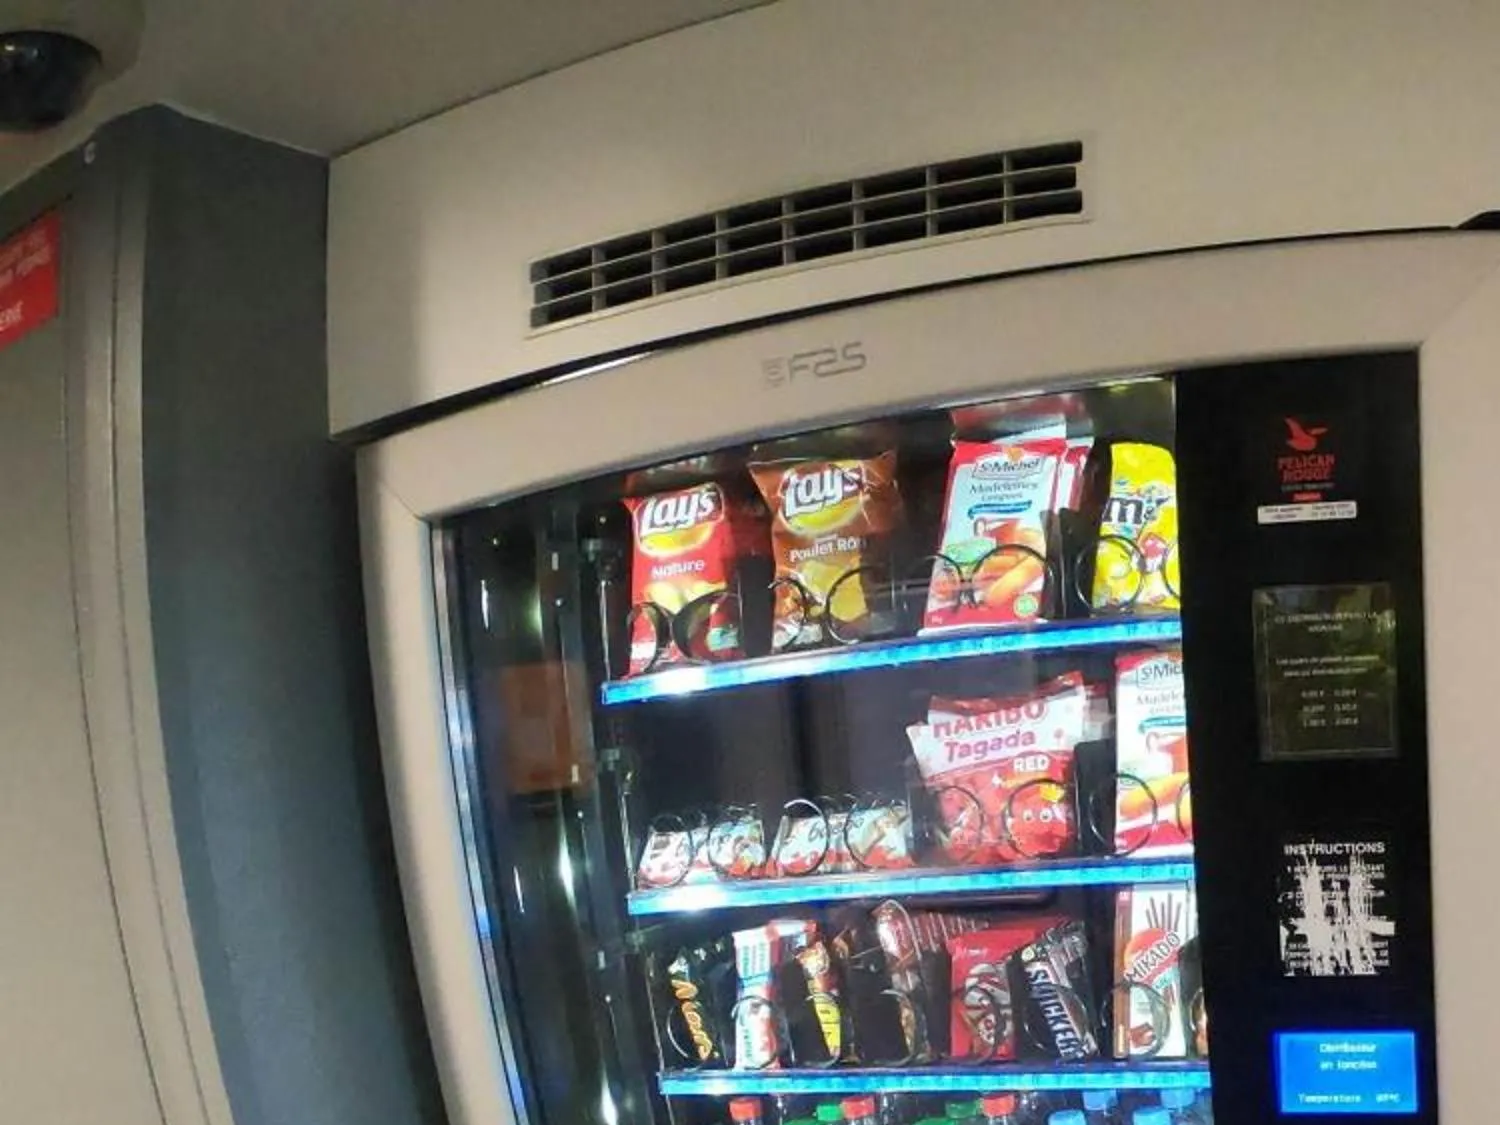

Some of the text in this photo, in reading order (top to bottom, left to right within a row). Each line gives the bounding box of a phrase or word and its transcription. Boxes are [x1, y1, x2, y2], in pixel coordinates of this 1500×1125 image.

[651, 559, 705, 580] Nature
[943, 728, 1037, 763] Tagada
[1012, 755, 1050, 773] RED
[1284, 840, 1386, 855] INSTRUCTIONS
[1126, 930, 1181, 983] MIKADO
